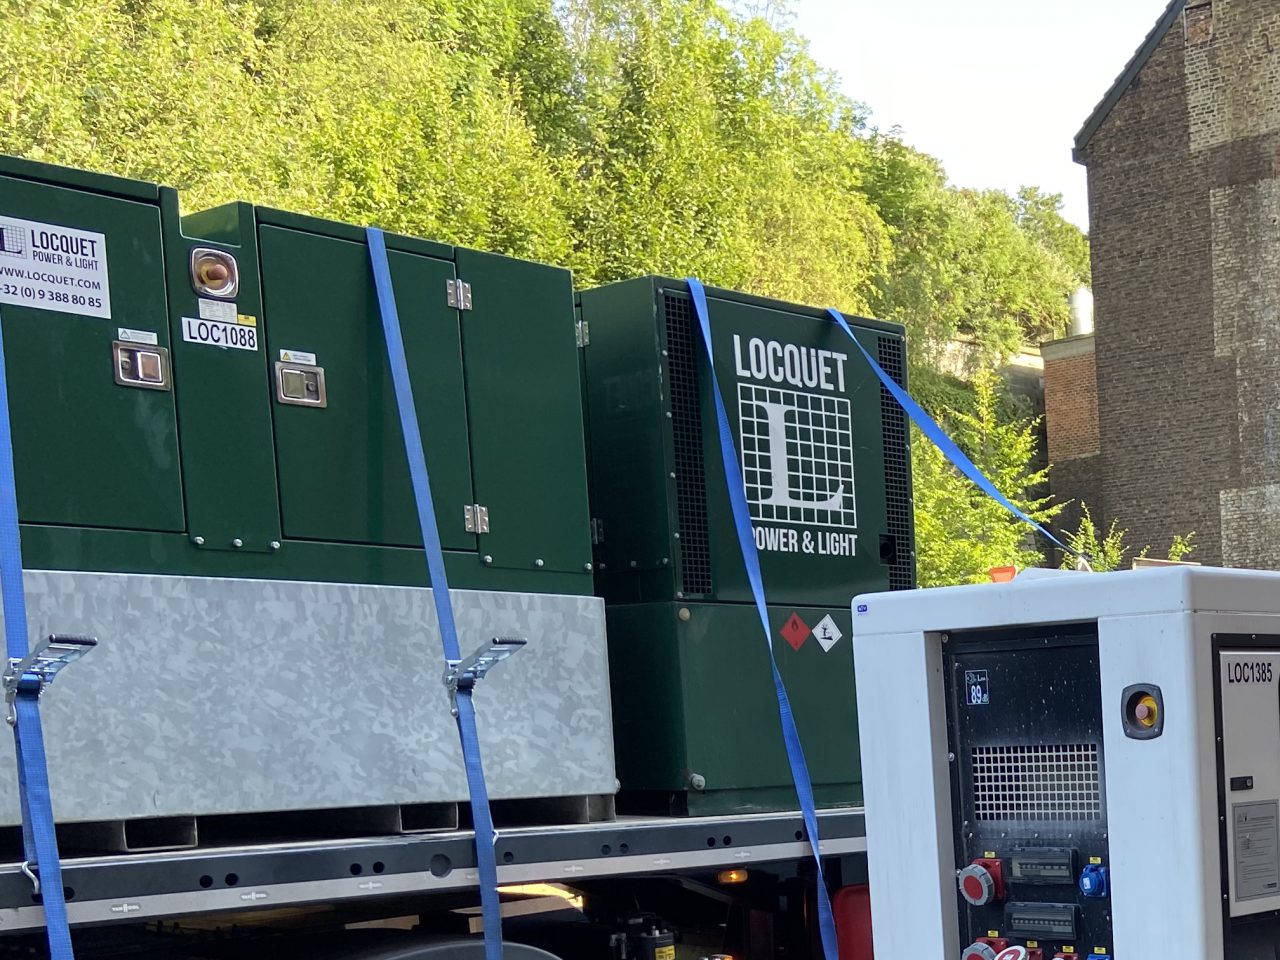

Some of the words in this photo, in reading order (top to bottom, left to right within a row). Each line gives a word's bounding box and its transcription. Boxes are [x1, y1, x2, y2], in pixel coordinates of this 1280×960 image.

[31, 230, 97, 258] LOCQUET
[32, 250, 63, 265] POWER
[66, 256, 73, 266] &
[75, 258, 98, 271] LIGHT
[20, 286, 36, 299] (0)
[38, 290, 45, 299] 9
[48, 291, 69, 303] 388
[72, 294, 86, 306] 80
[88, 298, 102, 308] 85
[188, 320, 256, 348] LOC1088
[733, 334, 848, 392] LOCQUET
[802, 530, 814, 554] &
[818, 532, 858, 556] LIGHT
[1228, 662, 1272, 683] LOC1385
[971, 684, 982, 704] 89
